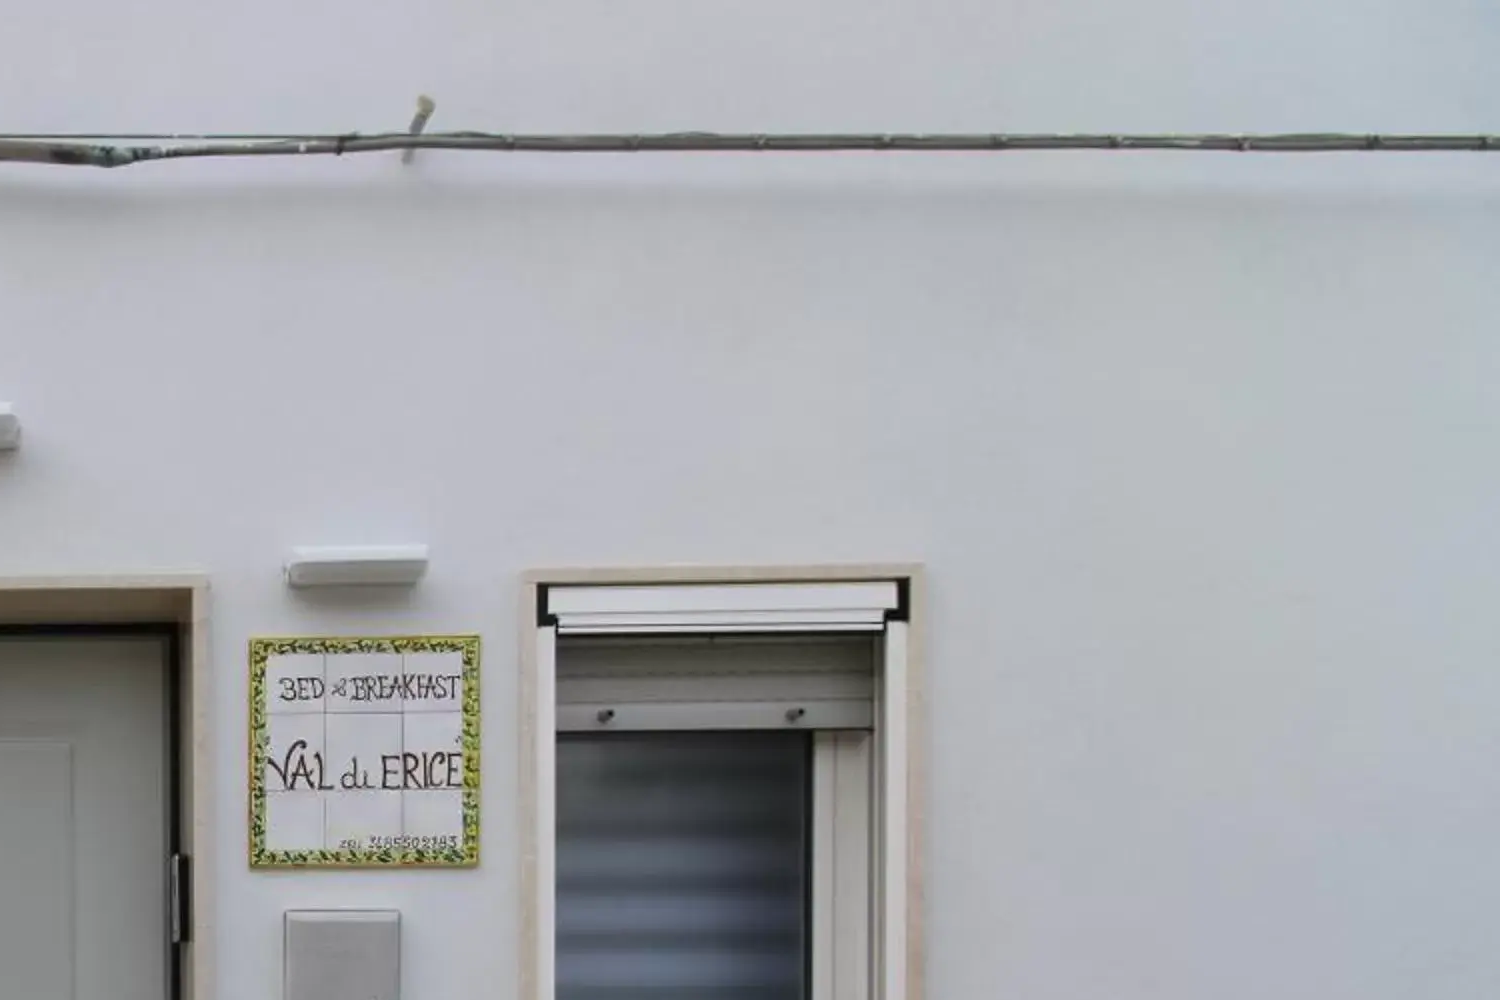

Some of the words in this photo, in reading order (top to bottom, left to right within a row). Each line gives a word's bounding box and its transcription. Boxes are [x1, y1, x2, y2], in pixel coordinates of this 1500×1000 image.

[278, 677, 325, 701] BED
[350, 674, 461, 702] BREAKFAST
[267, 739, 335, 790] VAL
[340, 756, 375, 789] di
[381, 752, 463, 790] ERICE
